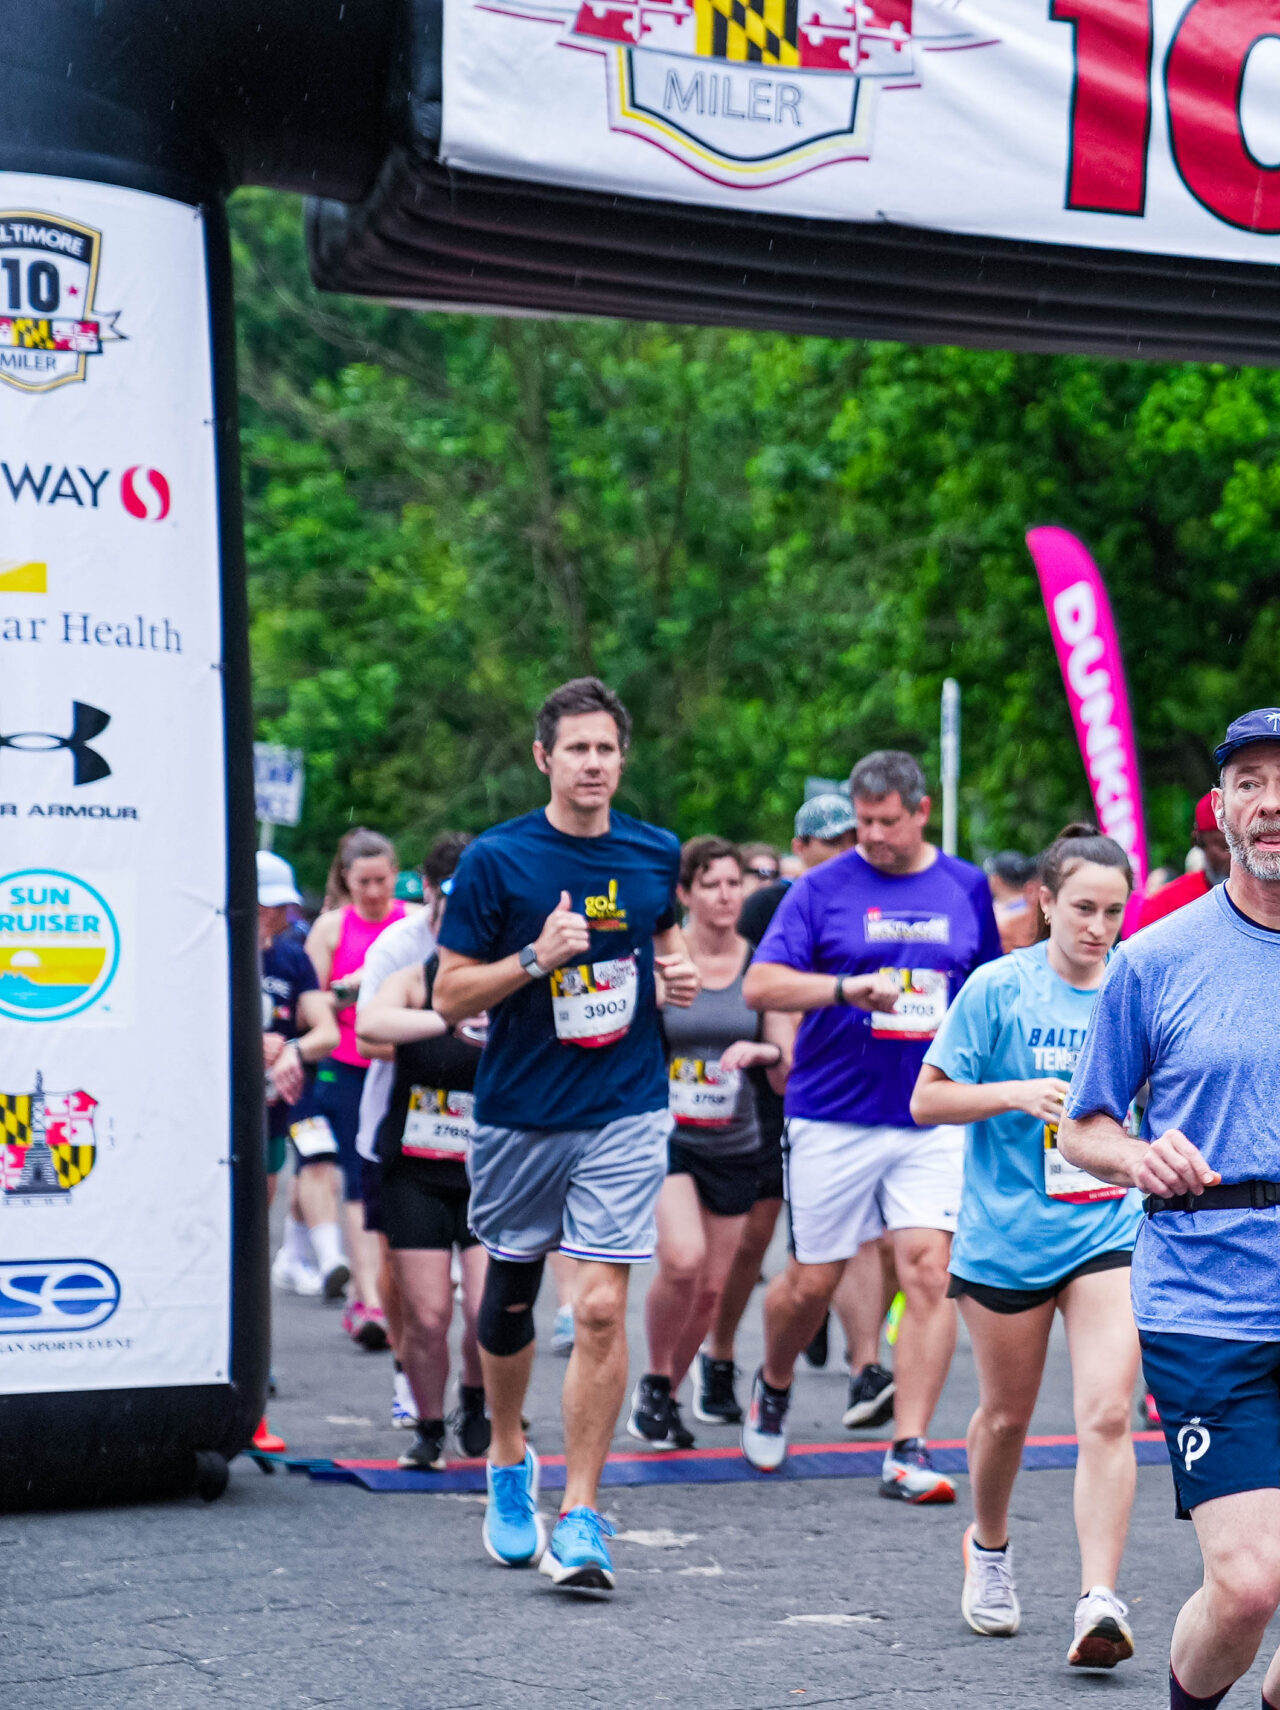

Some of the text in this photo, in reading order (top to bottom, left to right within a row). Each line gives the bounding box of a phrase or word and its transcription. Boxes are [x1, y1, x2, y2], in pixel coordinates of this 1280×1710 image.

[664, 68, 804, 127] MILER
[1, 257, 60, 313] 10
[1, 462, 110, 508] WAY
[3, 611, 182, 654] ar Health
[28, 805, 139, 820] ARMOUR
[10, 887, 70, 906] SUN
[584, 999, 626, 1019] 3903
